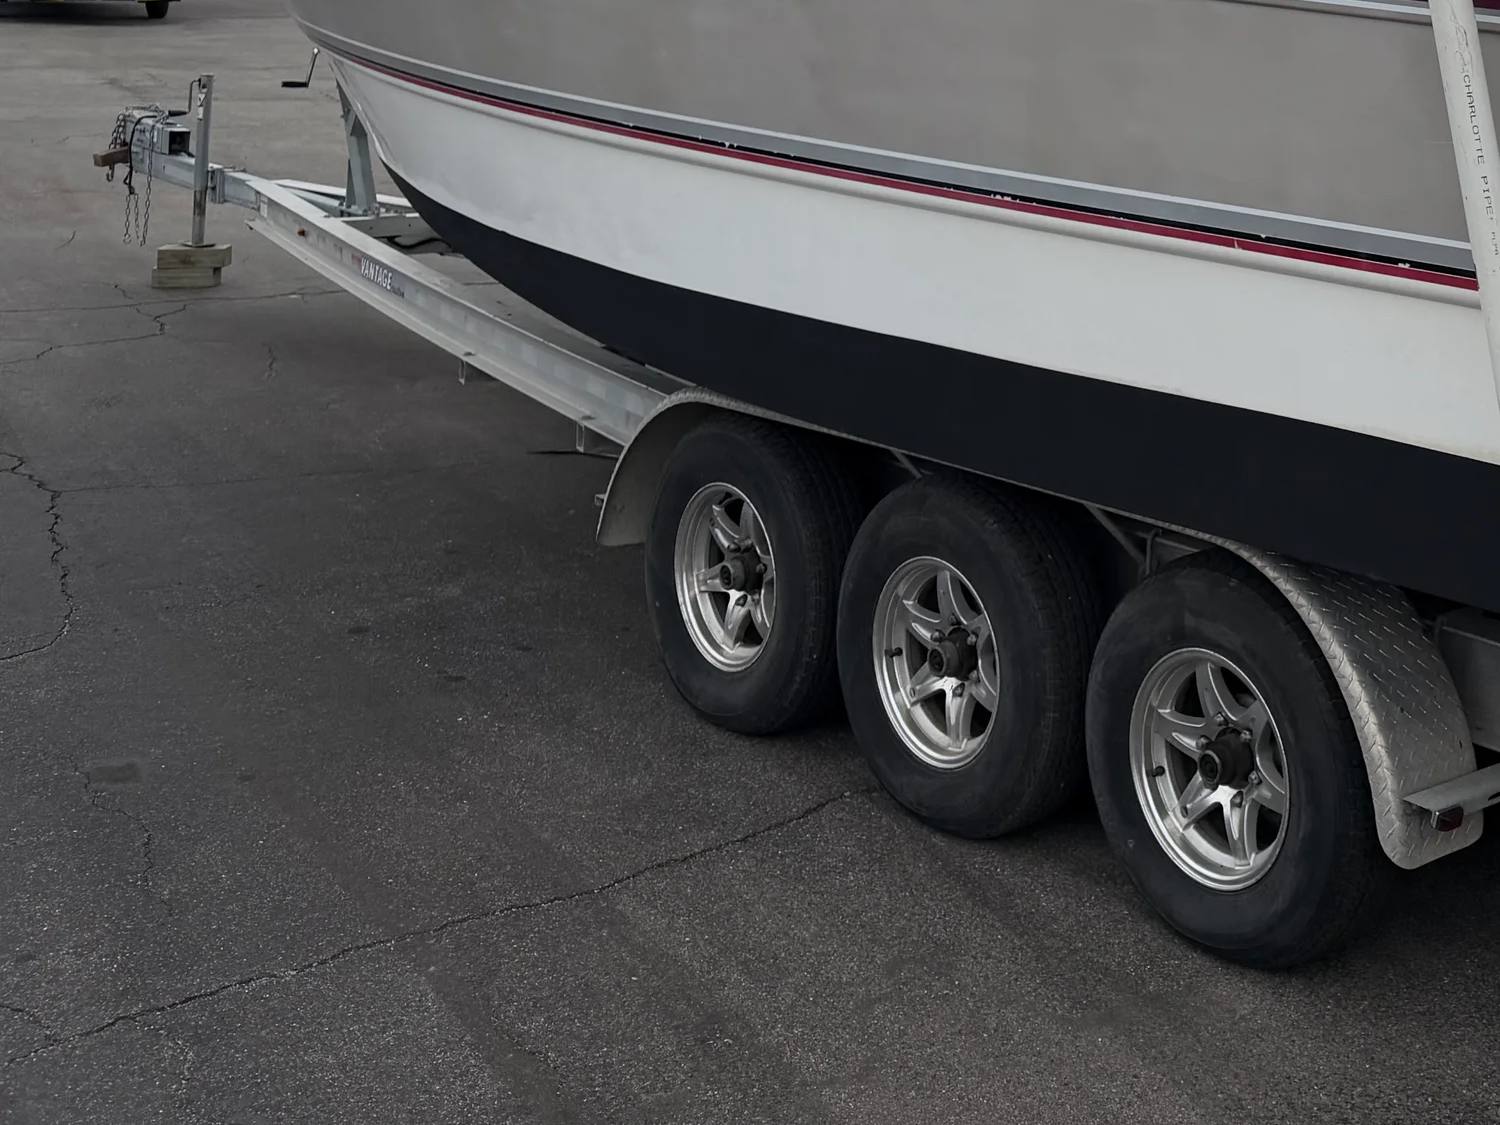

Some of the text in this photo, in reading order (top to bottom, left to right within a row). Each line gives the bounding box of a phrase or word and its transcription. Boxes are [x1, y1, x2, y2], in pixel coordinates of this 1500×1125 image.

[1463, 74, 1485, 164] CHARLOTTE
[1481, 175, 1494, 215] PIPE
[361, 257, 393, 290] VANTAGE
